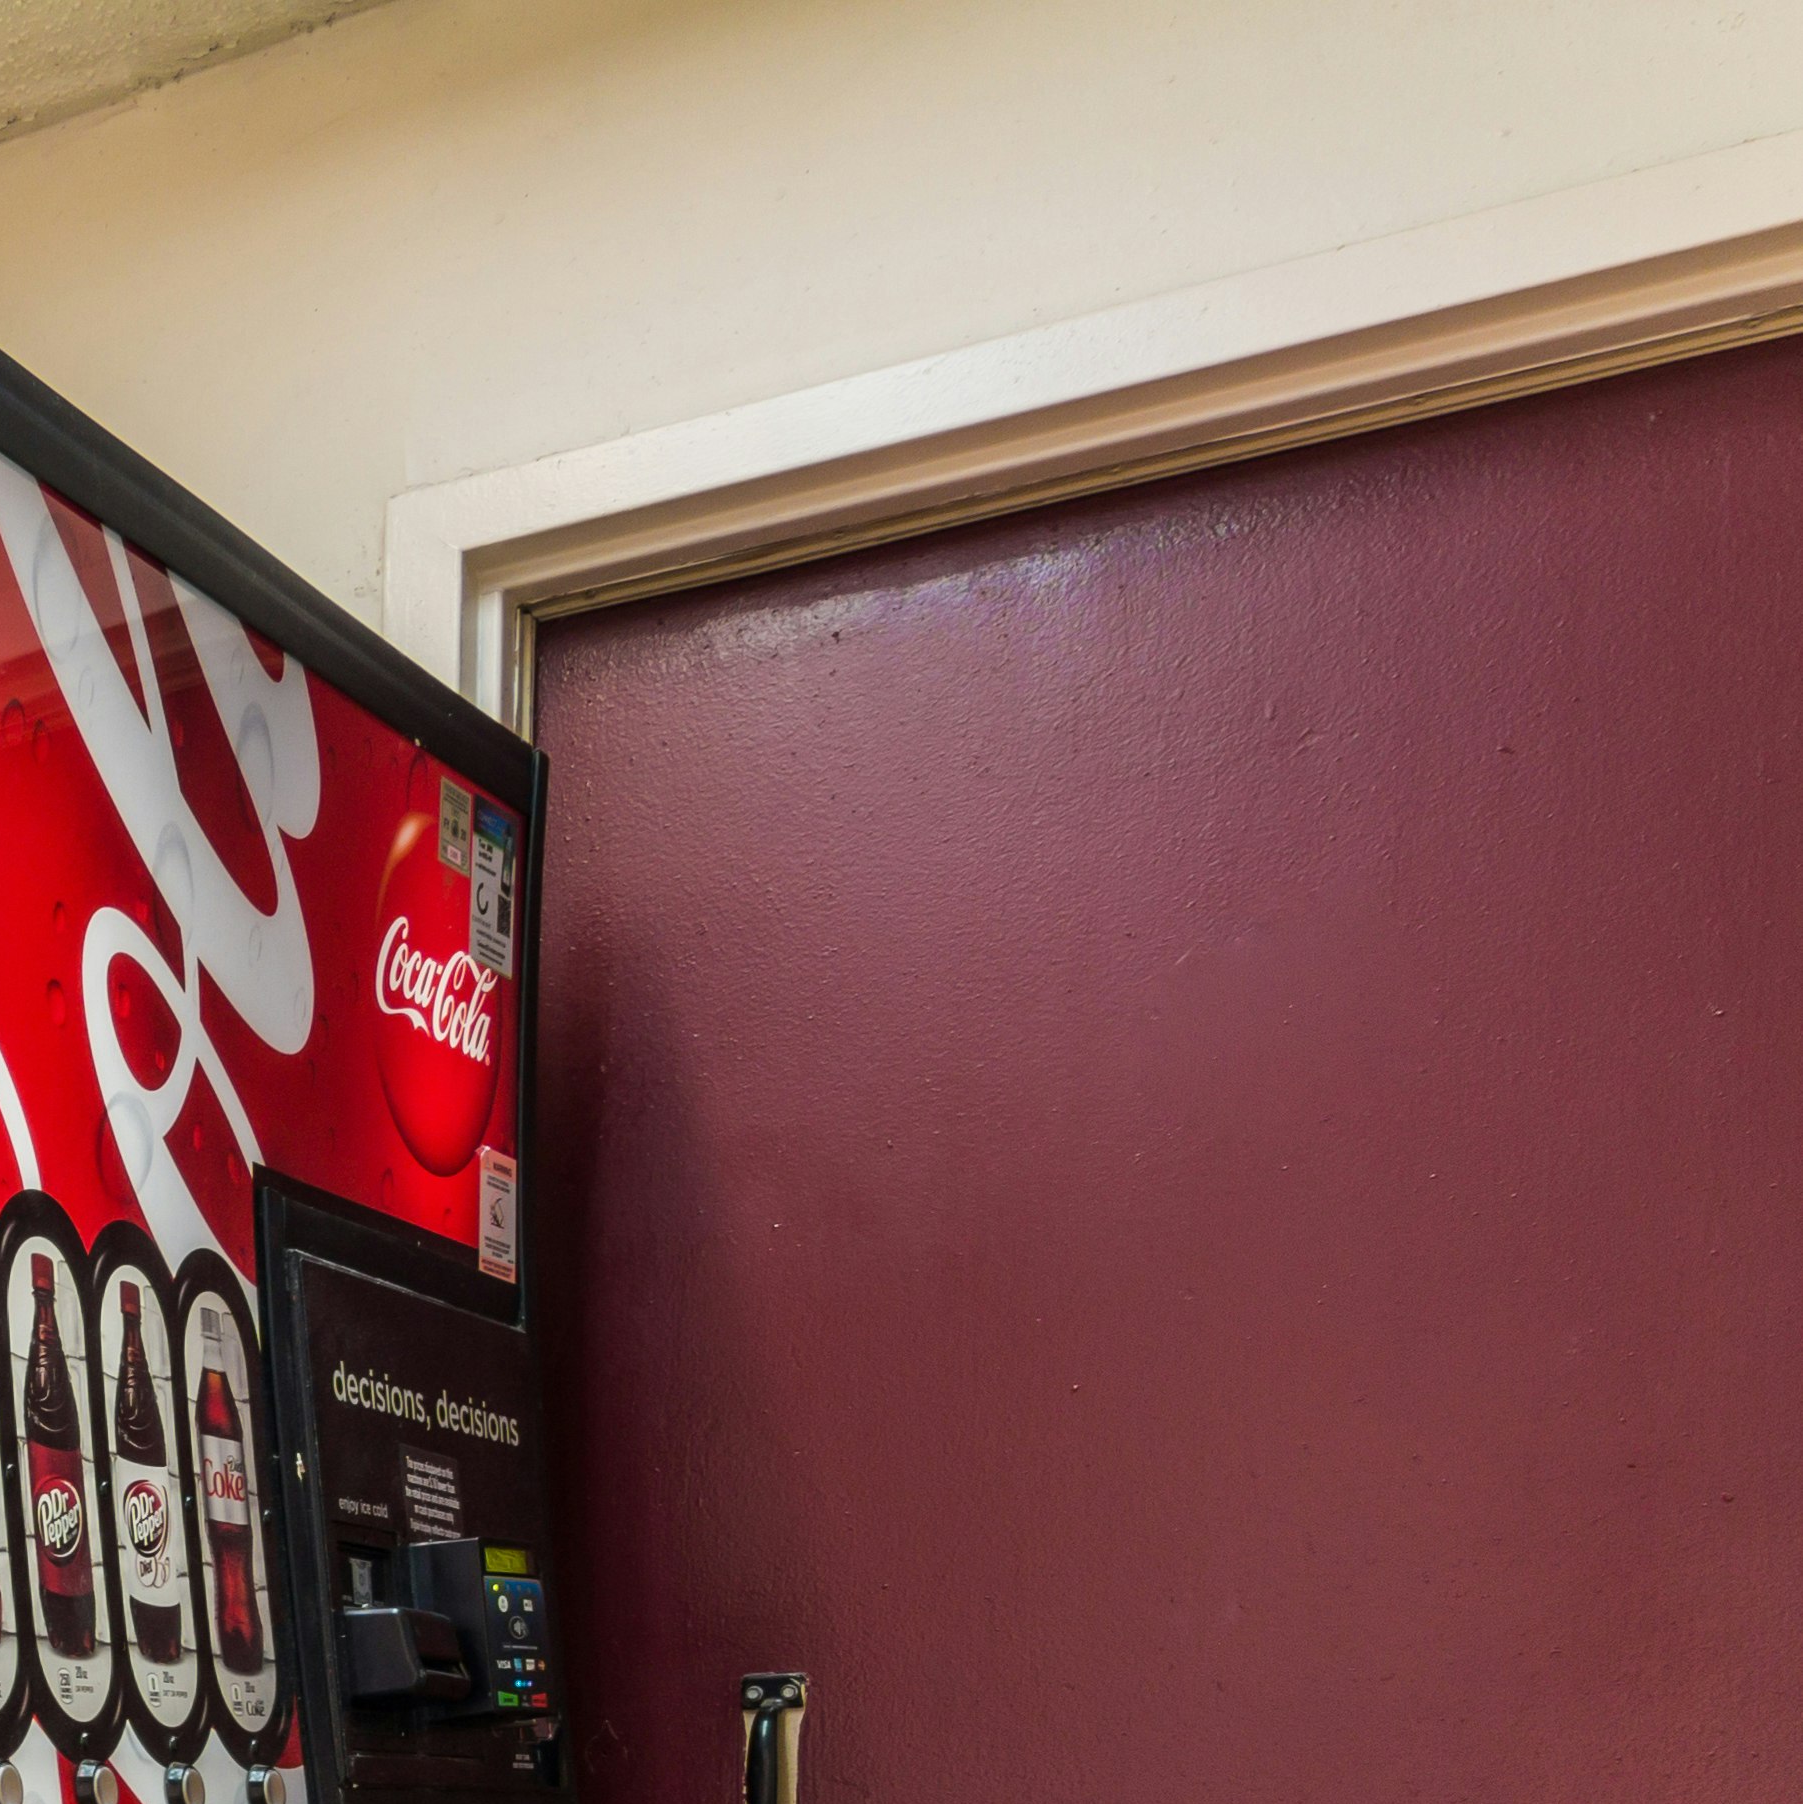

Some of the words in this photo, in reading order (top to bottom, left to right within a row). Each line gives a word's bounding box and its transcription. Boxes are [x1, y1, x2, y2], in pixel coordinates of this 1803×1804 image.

[376, 916, 498, 1064] Coca-Cola
[333, 1360, 431, 1431] decisions,
[436, 1389, 519, 1447] decisions
[204, 1458, 246, 1502] Coke
[50, 1488, 69, 1514] Dr
[139, 1492, 155, 1515] Dr
[339, 1497, 359, 1515] enjoy
[360, 1500, 372, 1515] ice
[372, 1502, 389, 1519] cold
[38, 1494, 80, 1549] Pepper
[130, 1496, 163, 1546] Pepper
[140, 1560, 153, 1578] Diet
[496, 1660, 511, 1669] VISA
